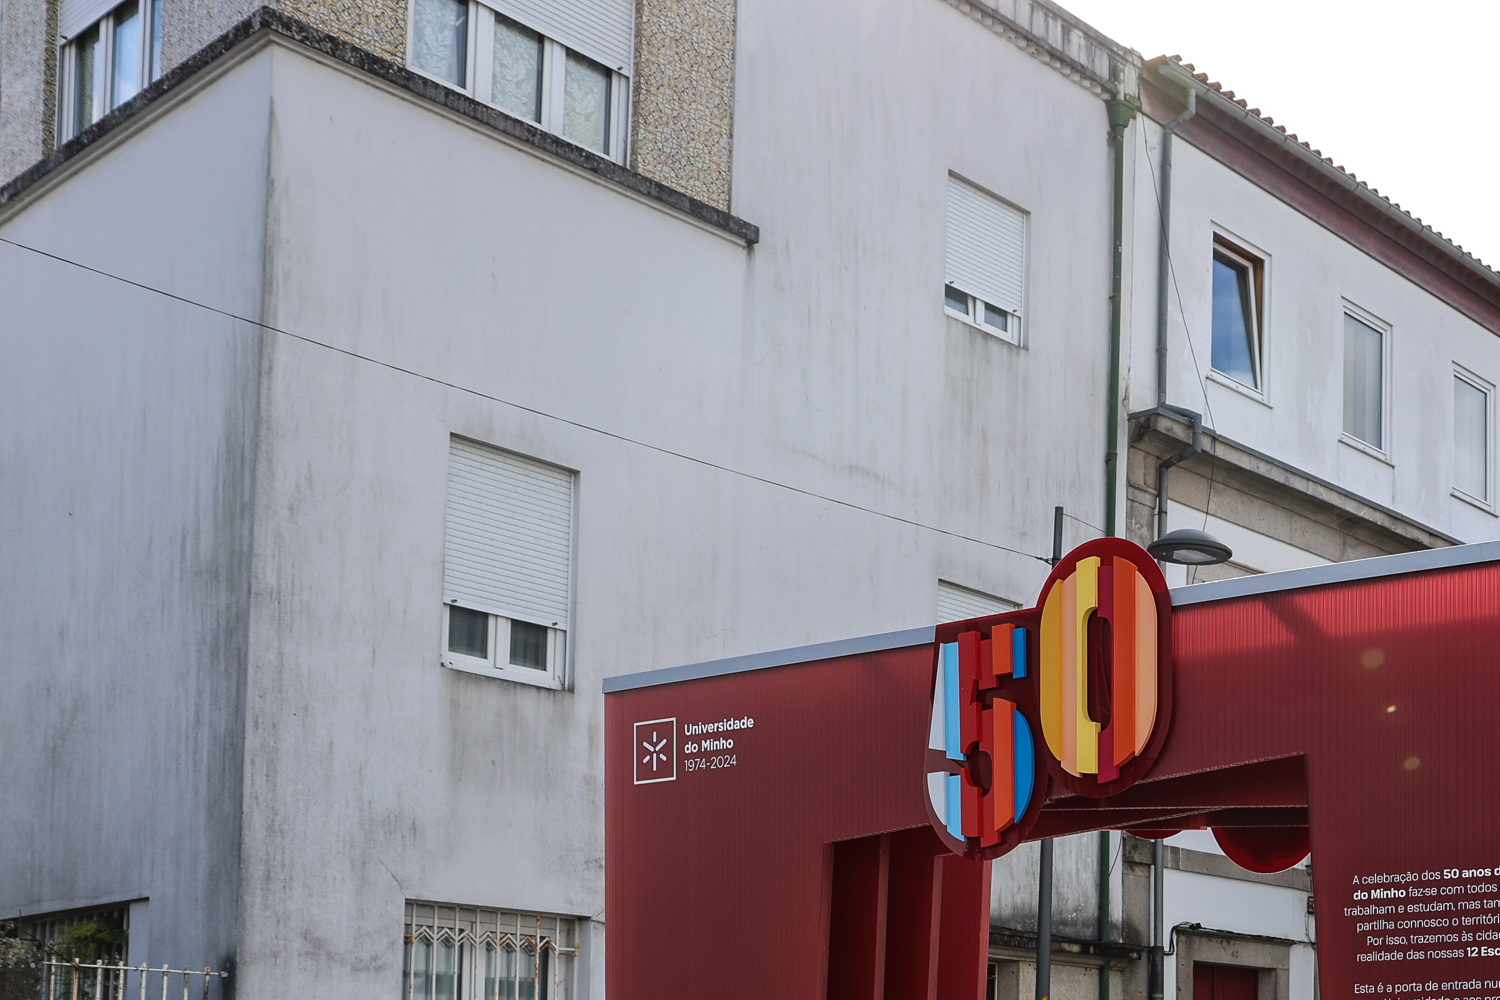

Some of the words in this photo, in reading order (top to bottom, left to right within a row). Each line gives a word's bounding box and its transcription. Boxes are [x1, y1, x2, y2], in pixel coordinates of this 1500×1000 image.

[927, 555, 1157, 848] 50
[685, 716, 754, 735] Universidade
[685, 742, 698, 753] do
[702, 738, 733, 751] Minho
[685, 755, 736, 771] 1974-2024
[1362, 873, 1418, 884] celebração
[1422, 870, 1440, 880] dos
[1444, 869, 1459, 879] 50
[1462, 869, 1491, 878] anos
[1371, 888, 1406, 899] Minho
[1409, 887, 1437, 896] faz-se
[1440, 886, 1464, 895] com
[1467, 882, 1497, 893] todos
[1344, 905, 1395, 916] trabalham
[1407, 901, 1455, 912] estudam,
[1458, 901, 1480, 909] mas
[1357, 920, 1394, 933] partilha
[1397, 919, 1449, 928] connosco
[1367, 936, 1383, 945] Por
[1386, 935, 1407, 945] isso,
[1410, 934, 1458, 944] trazemos
[1462, 931, 1473, 941] às
[1357, 950, 1403, 961] realidade
[1407, 950, 1425, 959] das
[1428, 950, 1464, 958] nossas
[1355, 984, 1374, 993] Esta
[1395, 982, 1422, 994] porta
[1442, 979, 1481, 990] entrada
